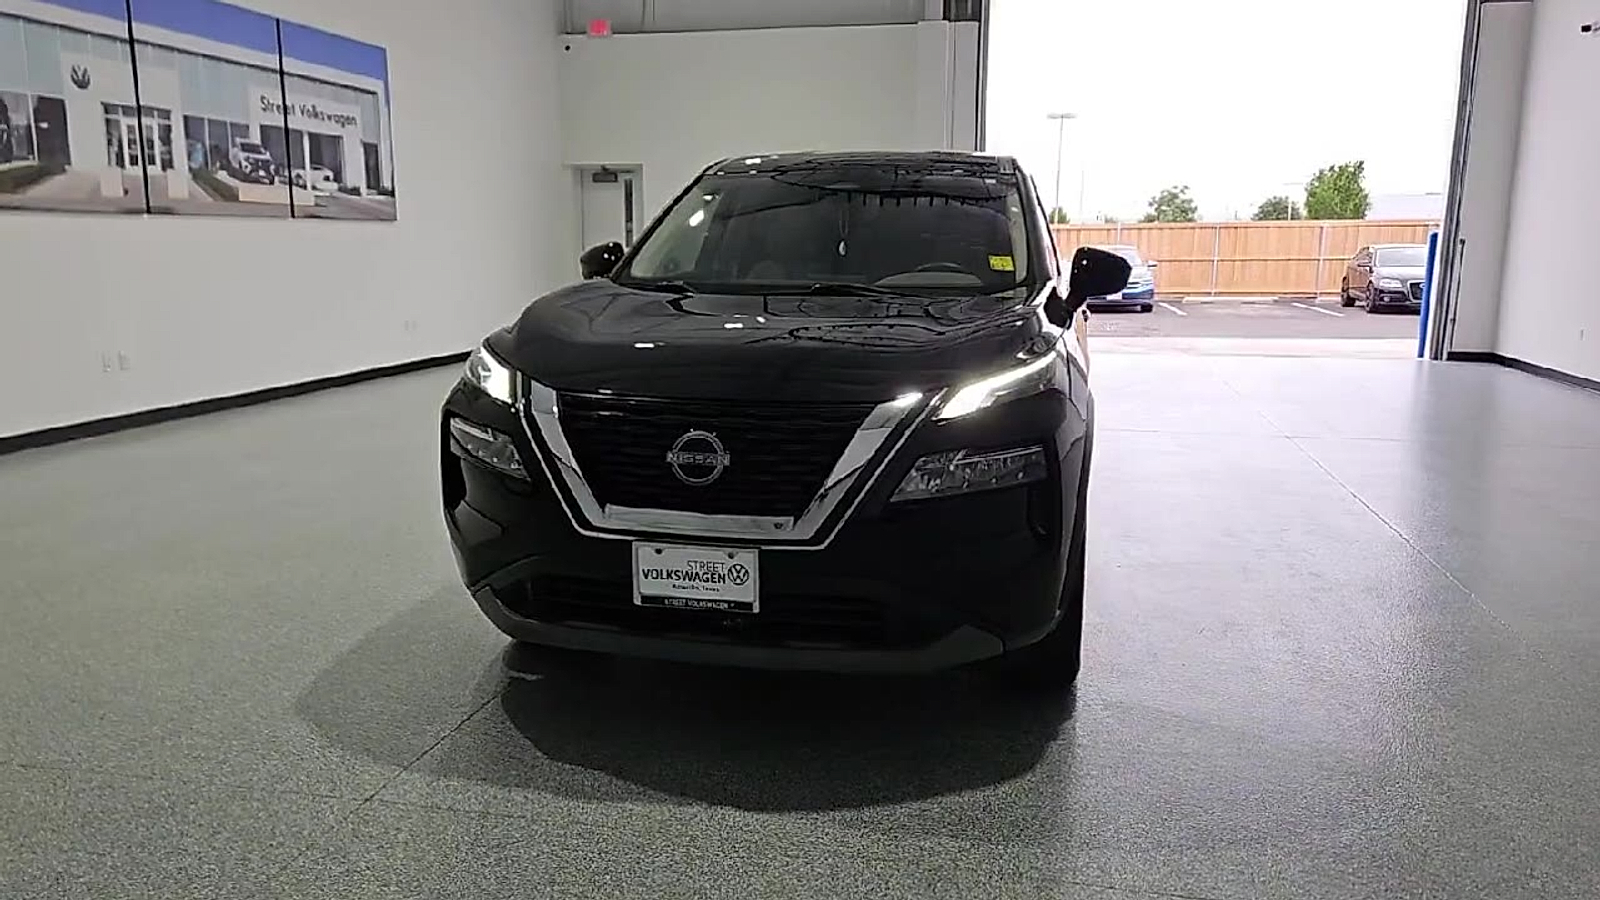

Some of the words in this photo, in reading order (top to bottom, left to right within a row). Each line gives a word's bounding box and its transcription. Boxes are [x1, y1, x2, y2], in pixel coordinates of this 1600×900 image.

[298, 103, 358, 129] Volkswagen
[666, 451, 730, 466] NISSAN
[687, 560, 725, 572] STREET
[642, 568, 726, 584] VOLKSWAGEN
